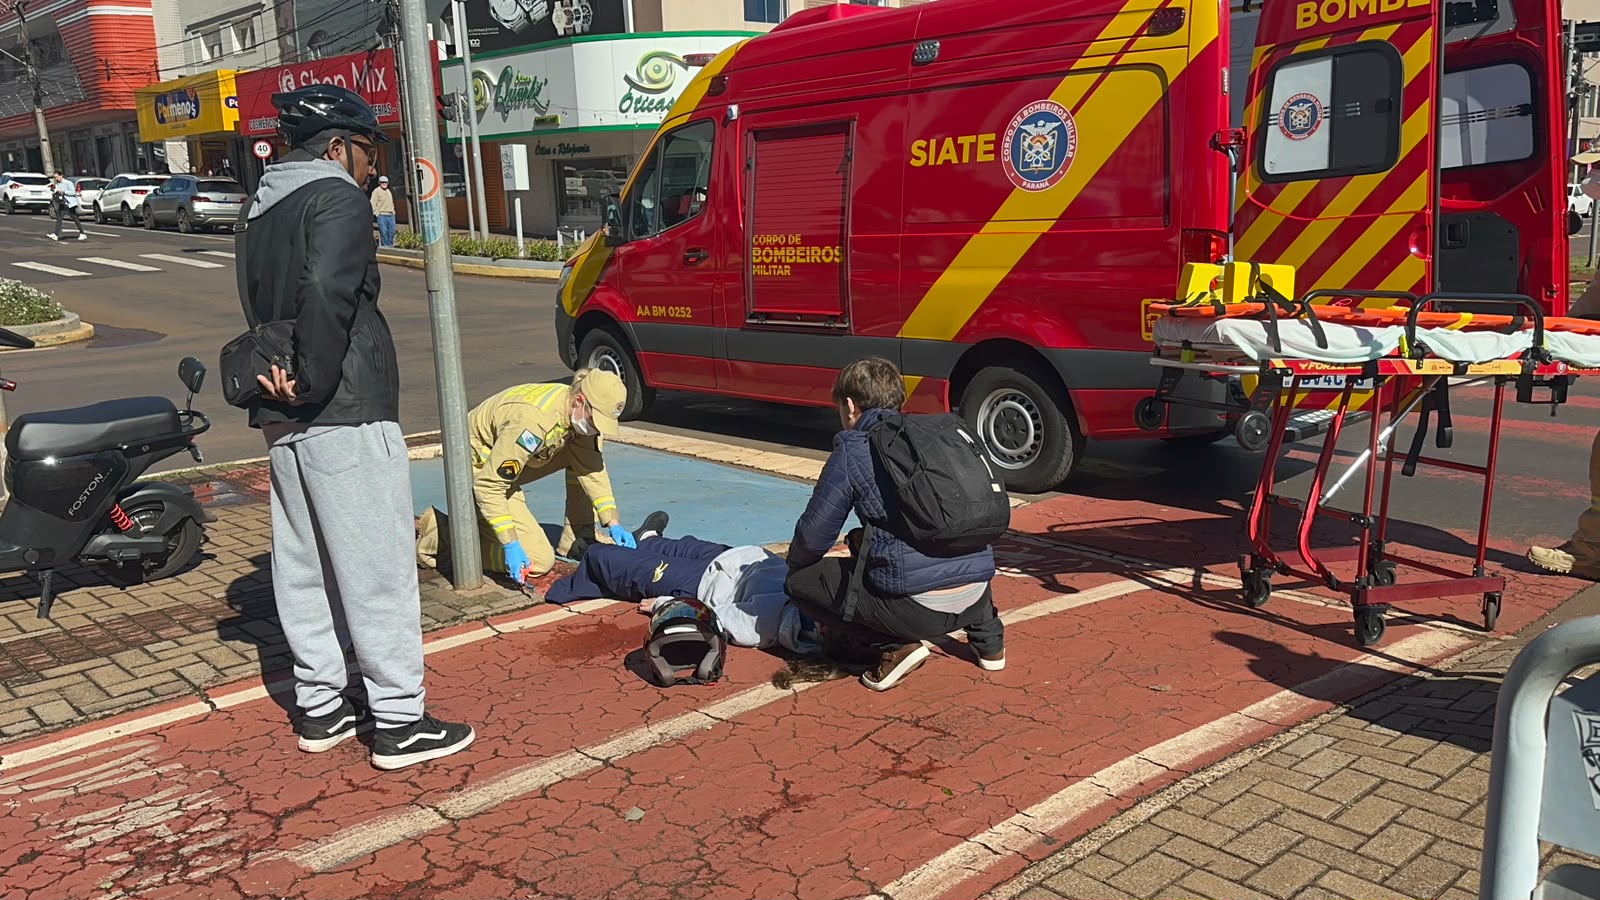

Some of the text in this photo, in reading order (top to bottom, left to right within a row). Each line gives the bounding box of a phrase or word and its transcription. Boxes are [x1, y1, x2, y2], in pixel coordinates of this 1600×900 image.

[351, 60, 388, 93] Mix
[1003, 103, 1076, 162] CORPO DE BOMBEIROS MILITAR
[256, 144, 268, 153] 40
[910, 132, 996, 168] SIATE
[1021, 180, 1050, 190] PARANÁ
[752, 234, 802, 246] CORPO DE
[752, 246, 844, 264] BOMBEIROS
[752, 265, 791, 277] MILITAR
[636, 305, 692, 319] AA BM 0252
[68, 472, 104, 516] FOSTON
